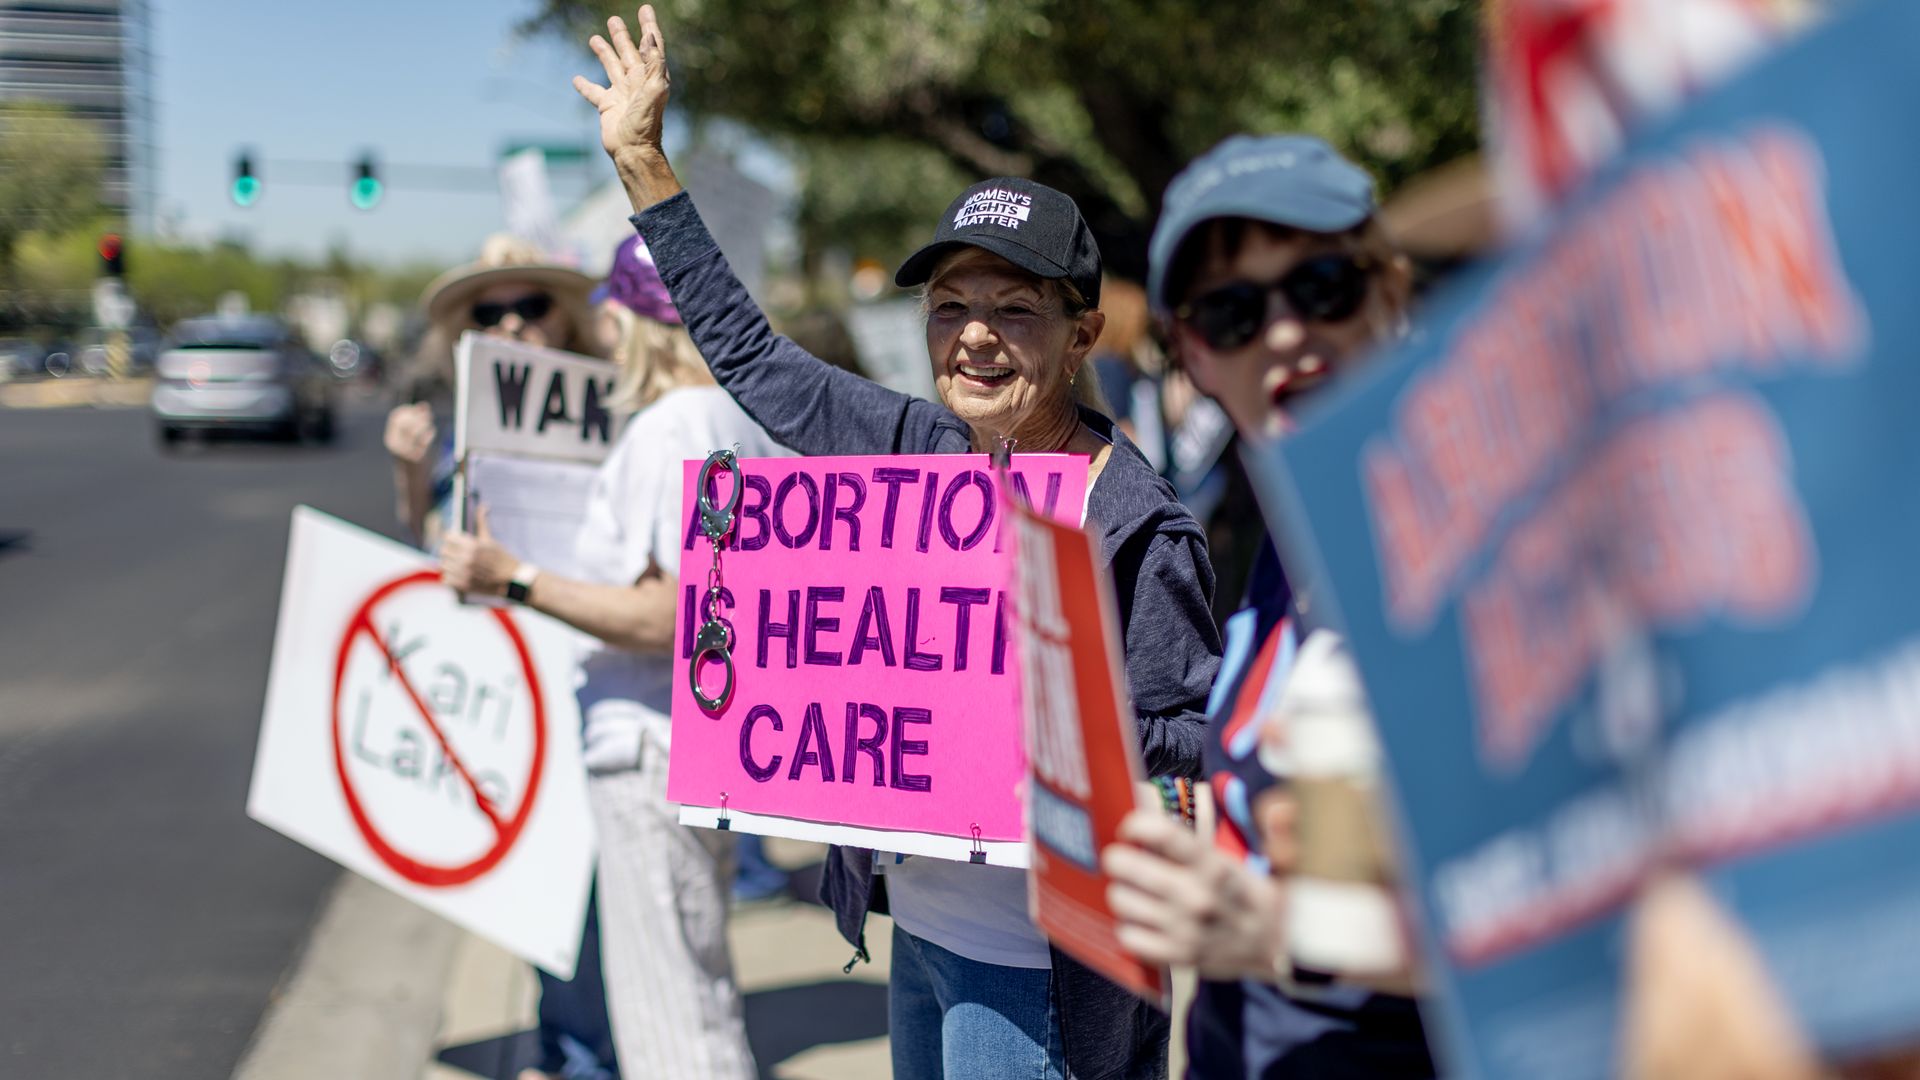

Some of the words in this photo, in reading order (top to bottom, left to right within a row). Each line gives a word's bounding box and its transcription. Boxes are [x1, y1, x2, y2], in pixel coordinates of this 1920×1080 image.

[954, 215, 1019, 231] MATTER
[964, 188, 1031, 207] WOMEN'S
[964, 201, 1018, 217] RIGHTS
[379, 618, 518, 742] Kari
[352, 686, 512, 808] Lake
[740, 702, 932, 792] CARE
